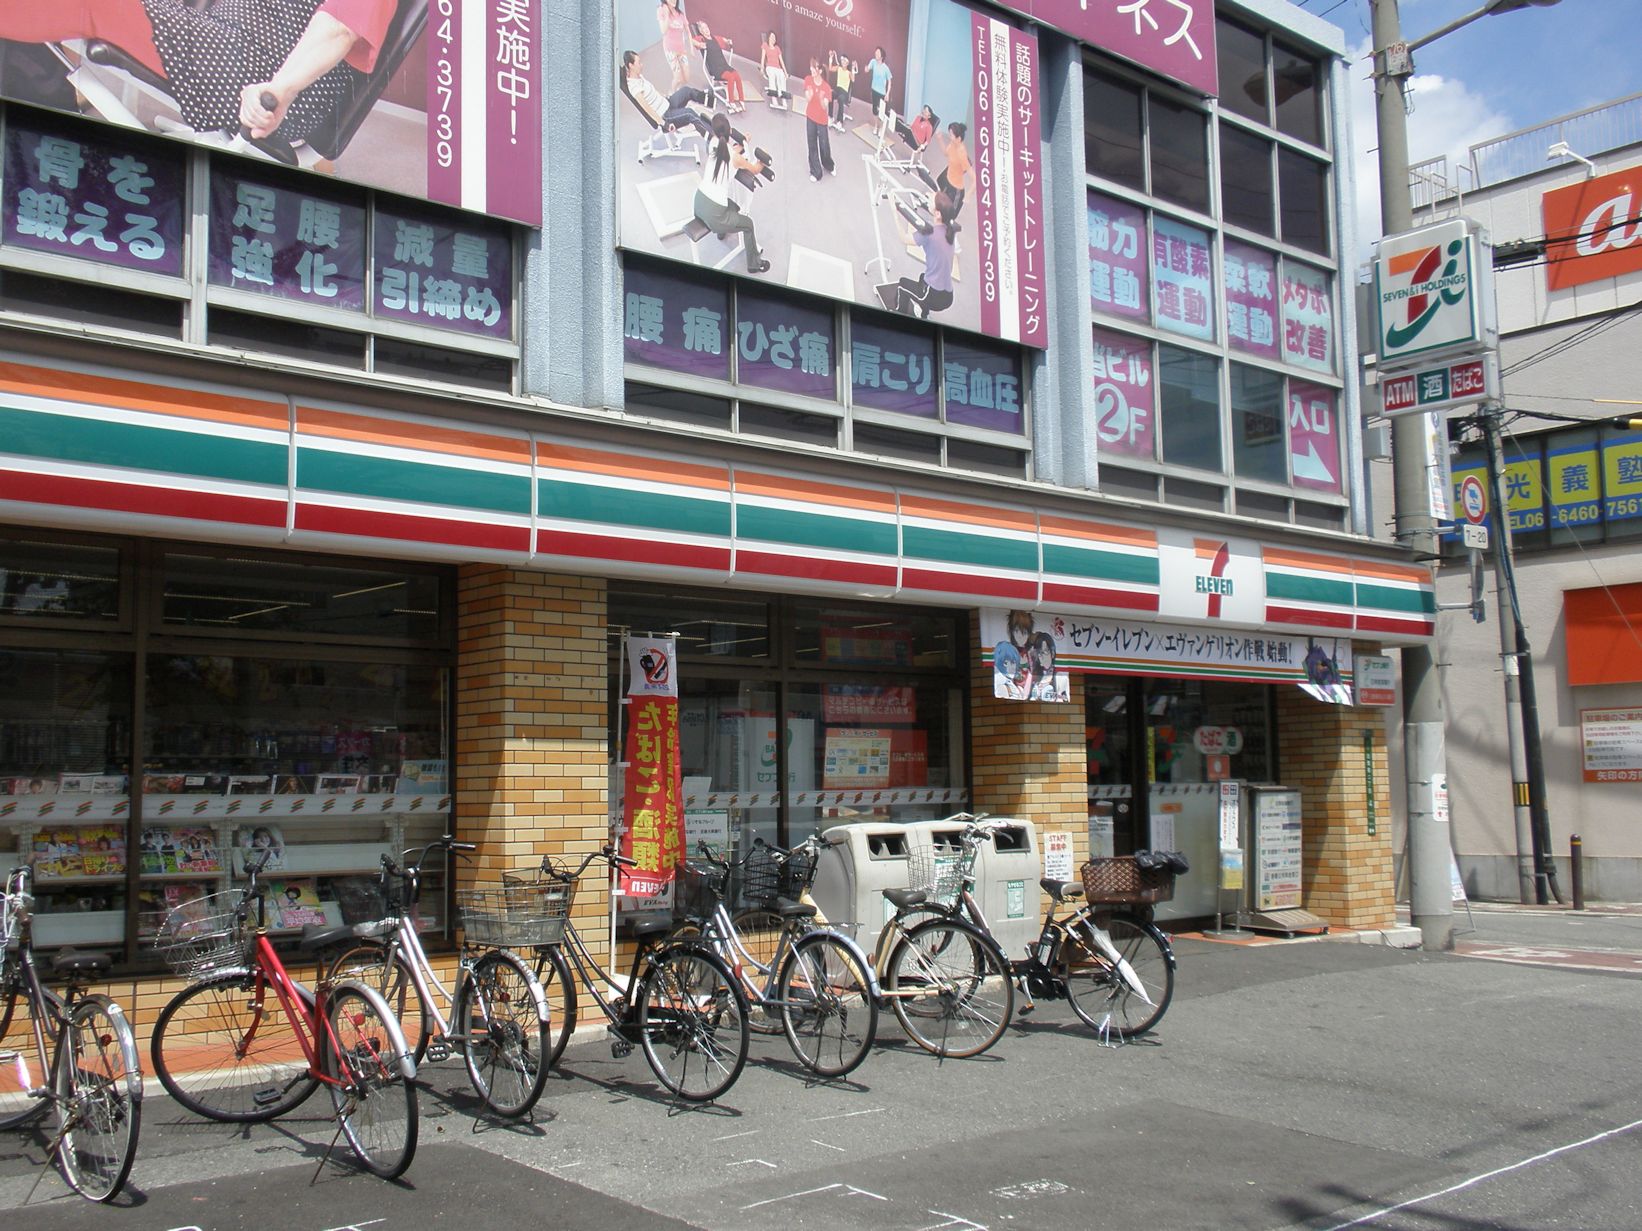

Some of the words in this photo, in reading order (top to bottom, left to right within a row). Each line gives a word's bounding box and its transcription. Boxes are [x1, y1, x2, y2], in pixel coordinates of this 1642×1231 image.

[795, 4, 824, 22] amaze
[1080, 0, 1202, 60] ネス
[35, 135, 155, 205] 骨を
[1015, 42, 1041, 335] 話題のサーキットトレーニング
[16, 187, 166, 260] 鍛える
[232, 183, 341, 250] 足腰
[231, 234, 339, 298] 強化
[395, 219, 489, 279] 減量
[1153, 229, 1209, 281] 有酸素
[380, 266, 502, 327] 引締め
[1090, 259, 1140, 310] 運動
[1223, 252, 1273, 301] 柔軟
[1282, 274, 1327, 316] メタボ
[1420, 272, 1466, 293] HOLDINGS
[624, 292, 721, 355] 腰痛
[1157, 279, 1207, 327] 運動
[1227, 300, 1274, 347] 運動
[738, 321, 830, 377] ひざ痛
[1285, 318, 1328, 361] 改善
[852, 341, 932, 396] 肩こり
[944, 362, 1020, 413] 高血圧
[1385, 380, 1414, 407] ATM
[1423, 374, 1443, 401] 酒
[1452, 366, 1484, 394] たばこ
[1290, 393, 1331, 435] 入口
[1466, 528, 1487, 544] 7-20
[1597, 770, 1642, 781] 矢印の方
